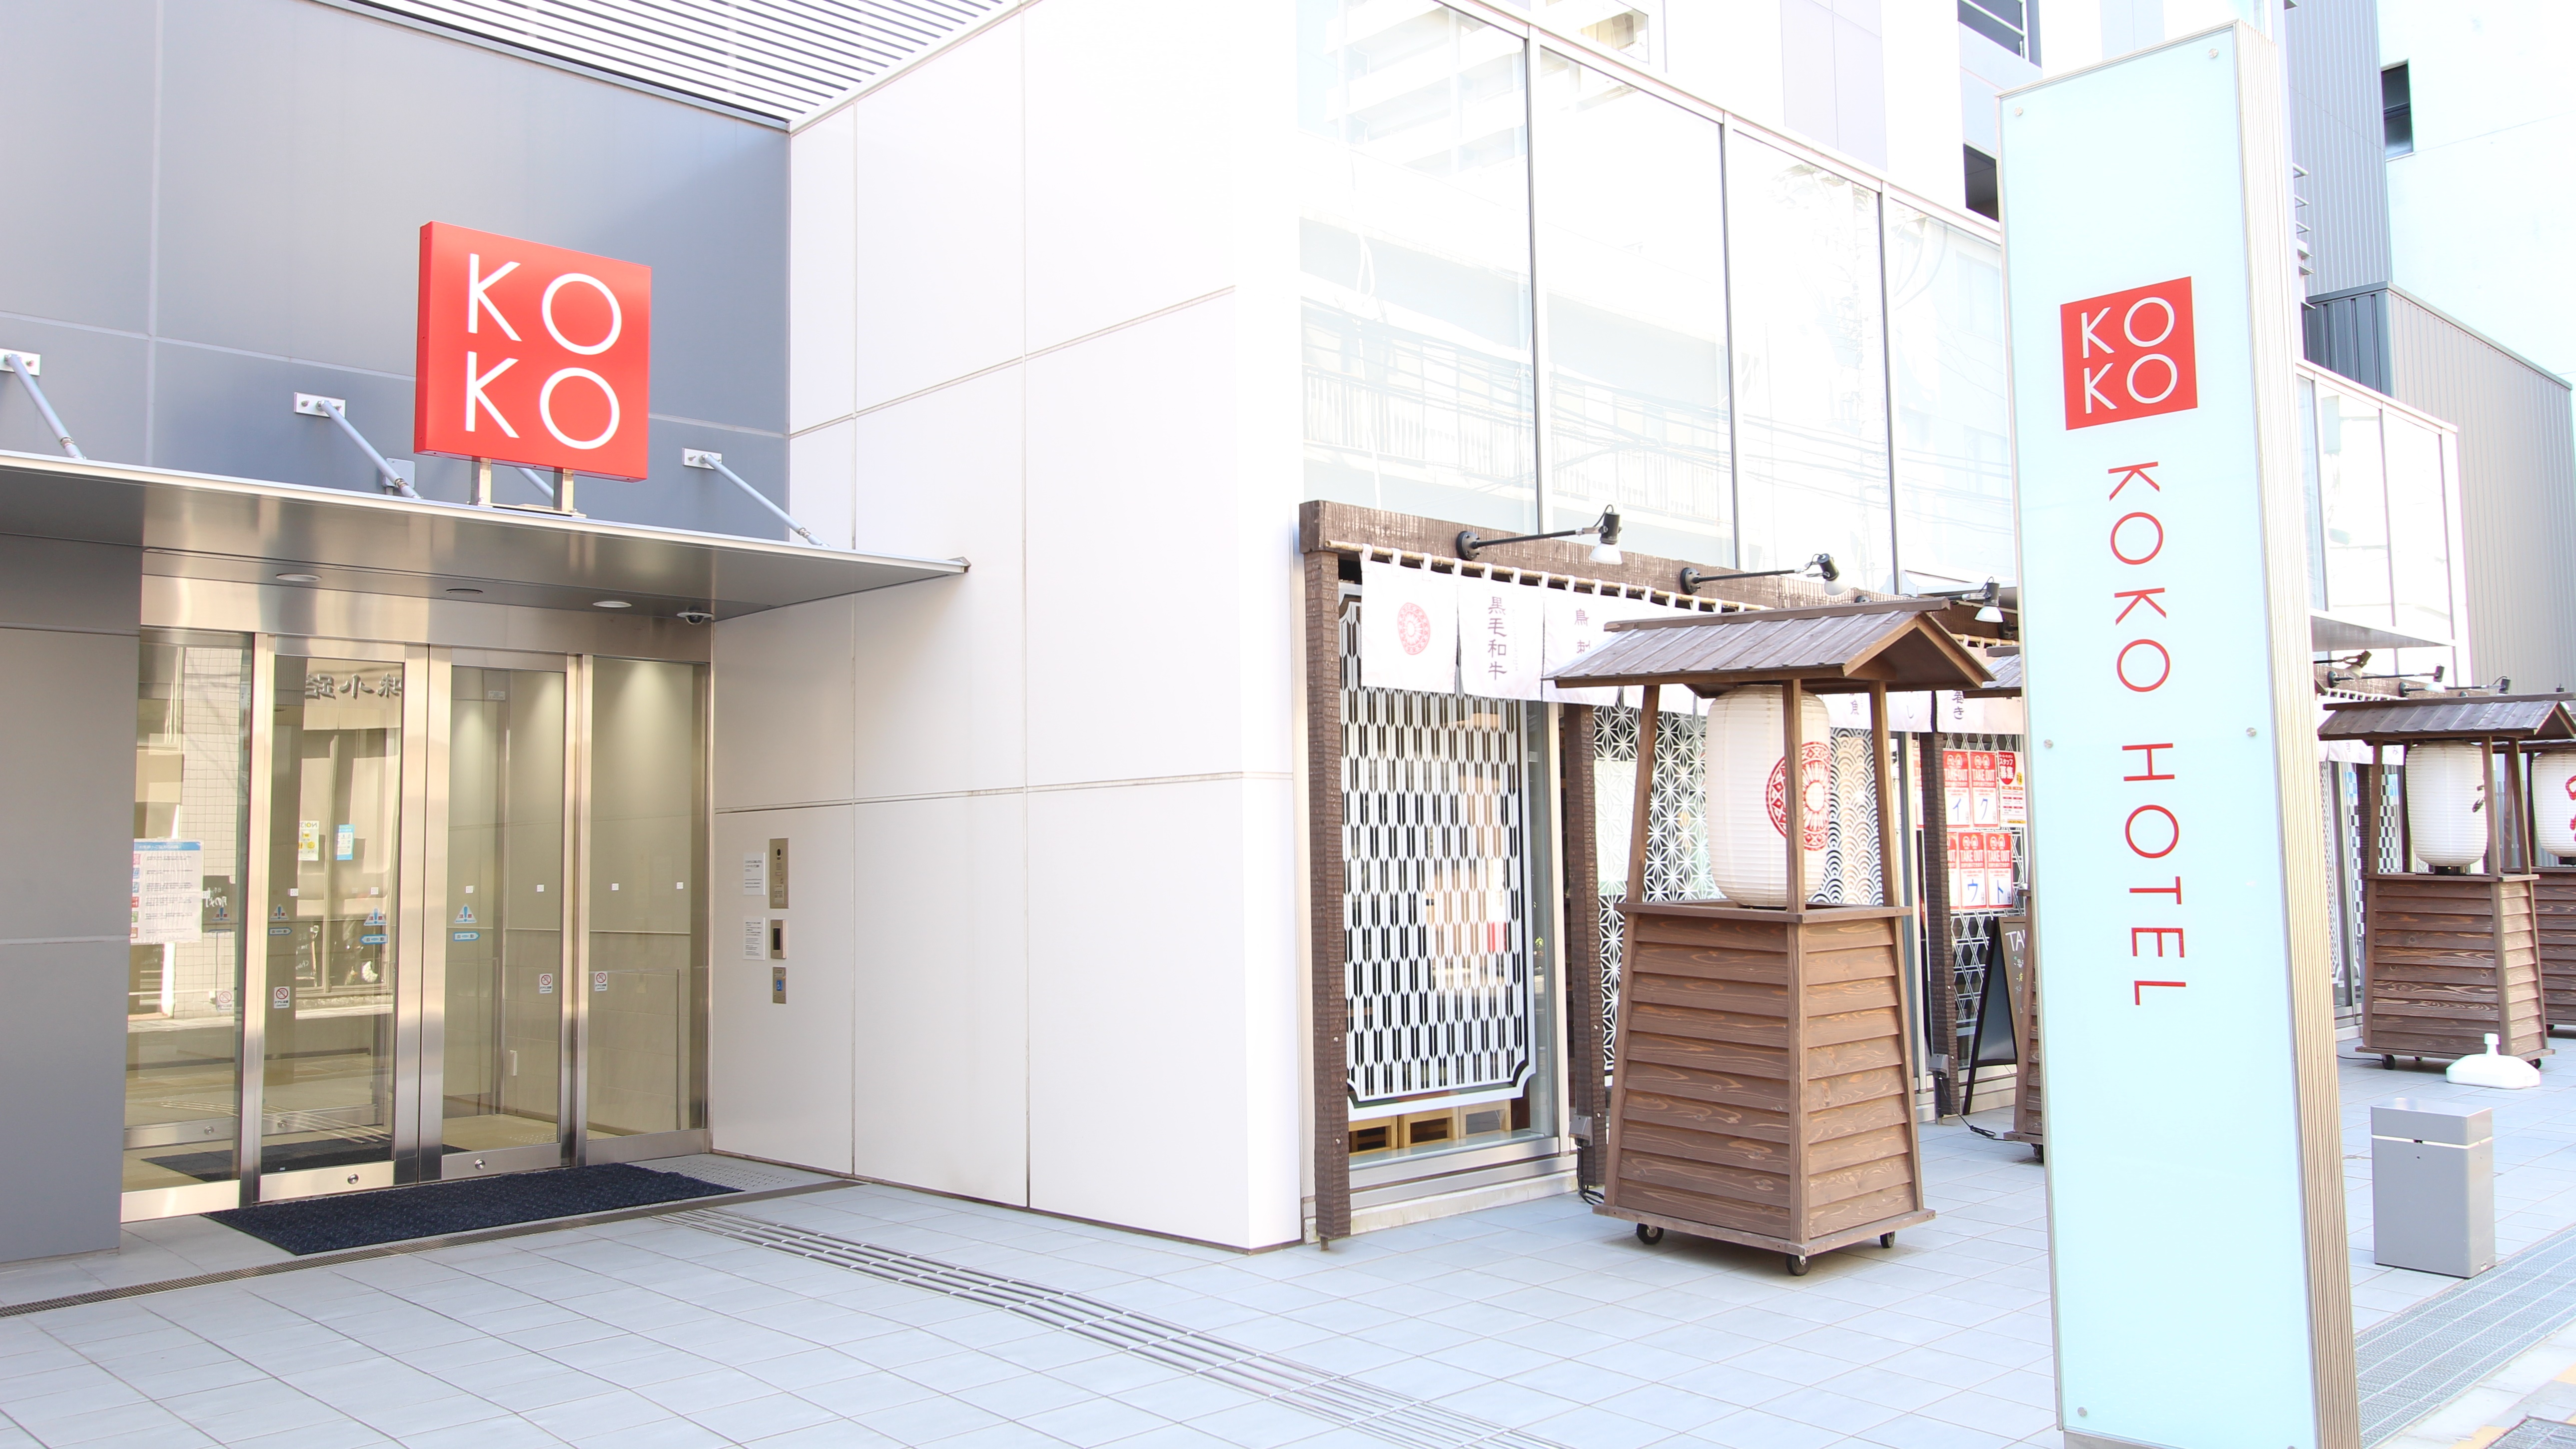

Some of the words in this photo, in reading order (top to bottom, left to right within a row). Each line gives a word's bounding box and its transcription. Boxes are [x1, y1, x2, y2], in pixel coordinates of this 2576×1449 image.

[468, 253, 622, 355] KO
[2081, 297, 2175, 359] KO
[465, 351, 620, 450] KO
[2083, 353, 2178, 414] KO
[2108, 461, 2170, 692] KOKO
[1487, 596, 1508, 680] 黒毛和牛
[1944, 768, 1957, 781] TAKE
[1958, 769, 1968, 781] OUT
[1972, 769, 1984, 781] TAKE
[1985, 769, 1995, 781] OUT
[2000, 766, 2014, 779] 募集
[1960, 850, 1973, 862] TAKE
[1974, 850, 1983, 862] OUT
[1987, 850, 2000, 862] TAKE
[2001, 850, 2010, 862] OUT
[2122, 742, 2186, 1006] HOTEL
[2005, 929, 2025, 952] TA
